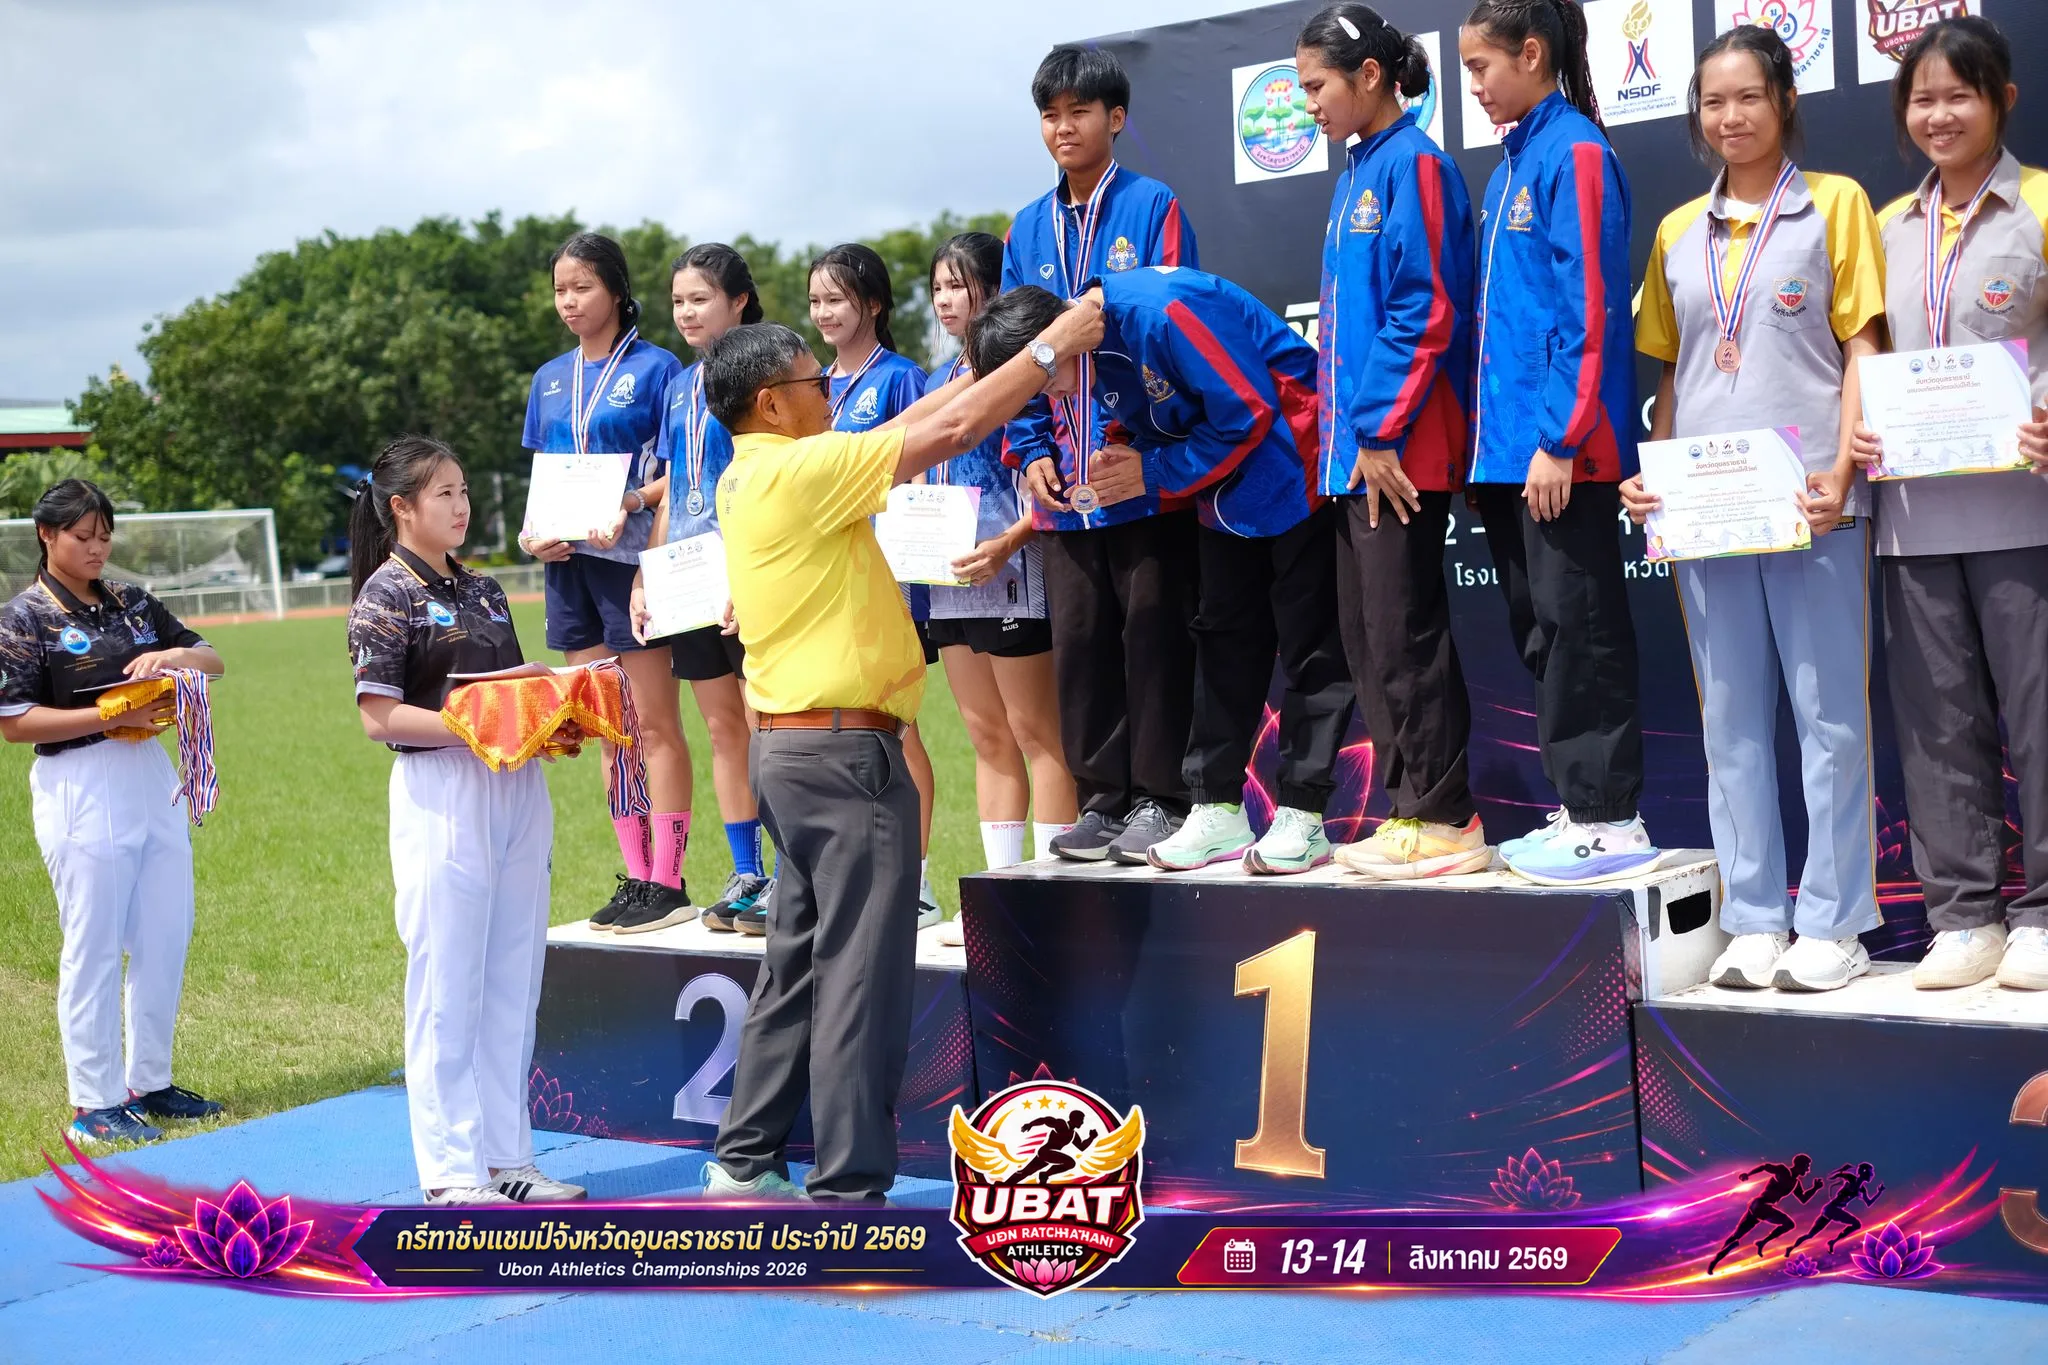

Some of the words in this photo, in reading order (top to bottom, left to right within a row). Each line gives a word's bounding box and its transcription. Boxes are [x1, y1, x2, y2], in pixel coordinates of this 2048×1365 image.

[1617, 83, 1662, 102] NSDF
[672, 972, 750, 1126] 2
[1234, 930, 1326, 1179] 1
